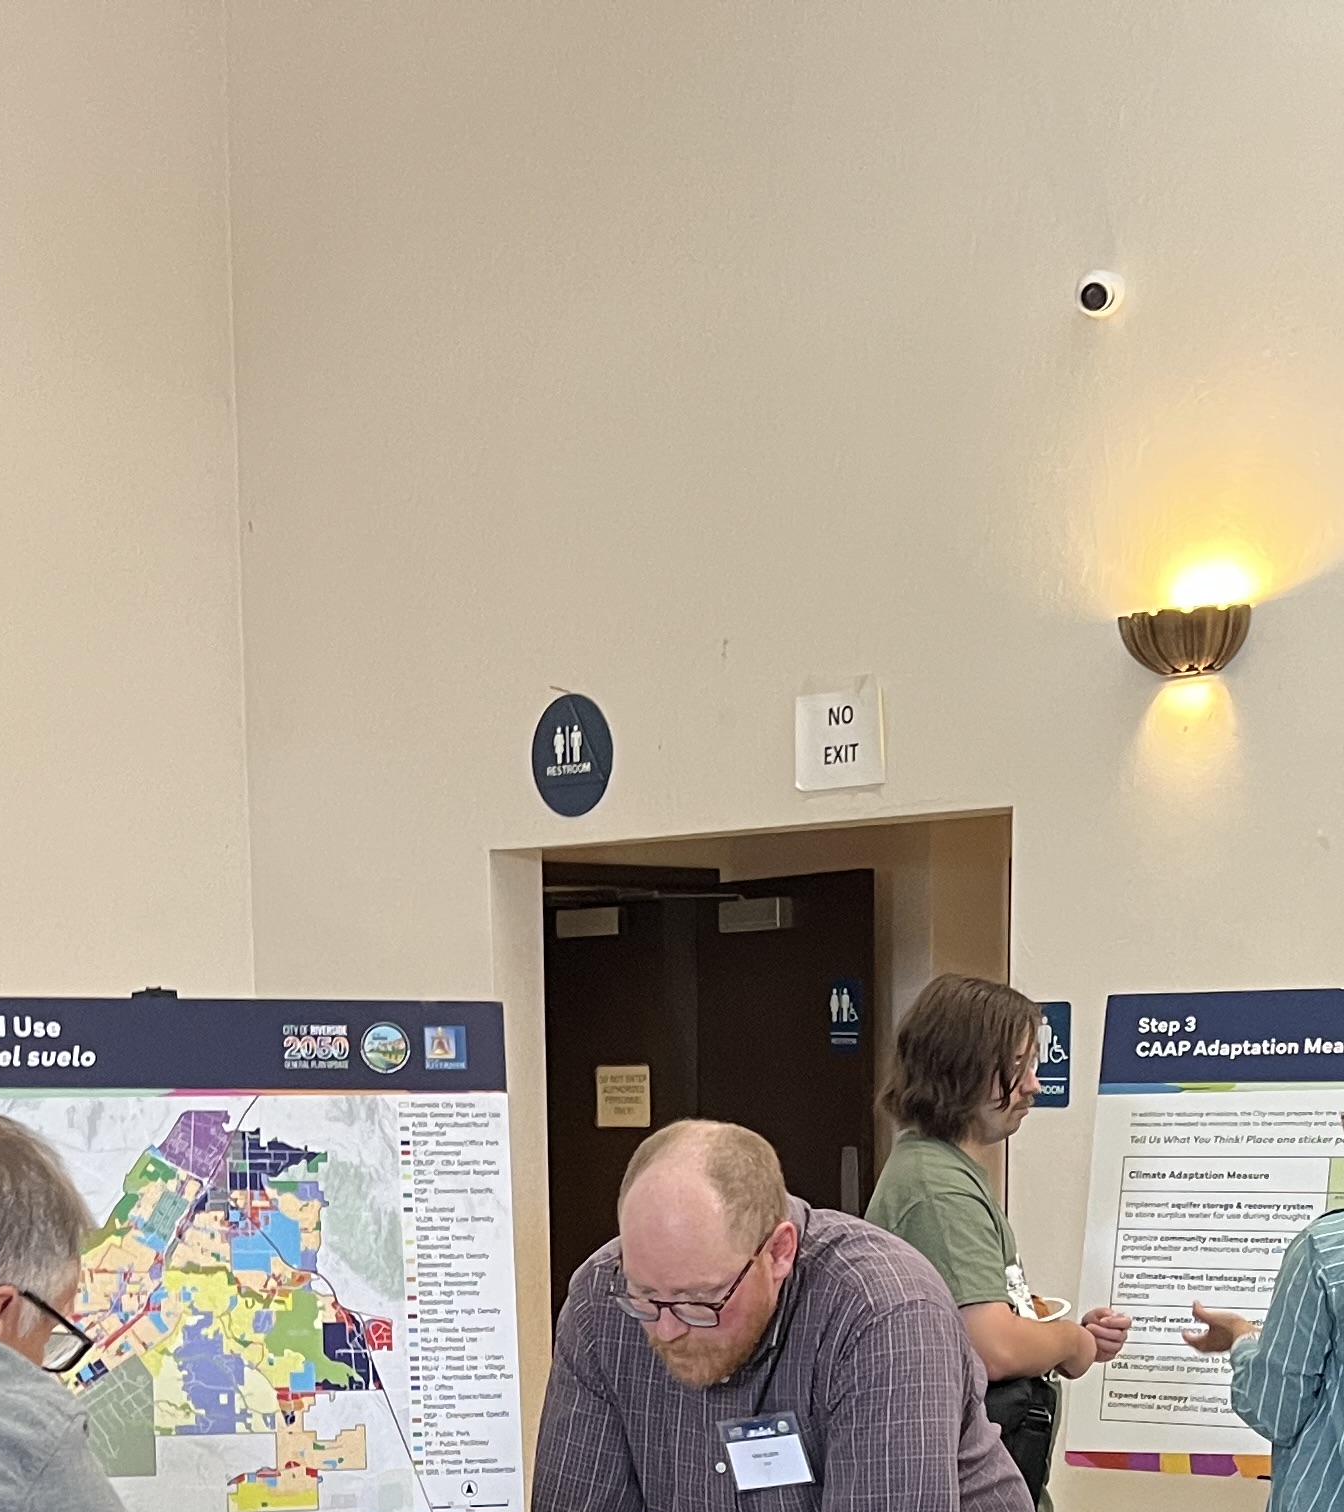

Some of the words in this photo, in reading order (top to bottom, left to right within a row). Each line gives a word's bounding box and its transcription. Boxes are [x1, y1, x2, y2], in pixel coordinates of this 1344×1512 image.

[829, 706, 853, 726] NO
[824, 743, 859, 765] EXIT
[547, 762, 591, 776] RESTROOM
[14, 1016, 61, 1037] Use
[283, 1025, 298, 1035] CITY
[300, 1025, 308, 1035] OF
[1138, 1017, 1180, 1036] Step
[1184, 1016, 1196, 1032] 3
[284, 1036, 349, 1059] 2050
[1136, 1041, 1191, 1057] CAAP
[1193, 1039, 1299, 1059] Adaptation
[27, 1045, 96, 1067] suelo
[1040, 1085, 1064, 1094] ROOM
[1130, 1136, 1146, 1144] Tell
[1149, 1136, 1161, 1144] Us
[1163, 1136, 1190, 1144] What
[1194, 1136, 1211, 1144] You
[1214, 1135, 1244, 1144] Think!
[1246, 1135, 1274, 1144] Place
[1298, 1135, 1332, 1144] sticker
[1129, 1171, 1166, 1180] Climate
[1169, 1171, 1224, 1181] Adaptation
[1227, 1171, 1269, 1180] Measure
[1126, 1202, 1169, 1210] Implement
[1171, 1202, 1200, 1210] aquifer
[1202, 1202, 1233, 1211] storage
[1244, 1203, 1280, 1211] recovery
[1283, 1203, 1313, 1211] system
[1213, 1211, 1224, 1219] for
[1243, 1212, 1269, 1221] during
[1272, 1213, 1310, 1221] droughts
[1123, 1234, 1158, 1243] Organize
[1160, 1235, 1206, 1244] community
[1209, 1235, 1248, 1243] resilience
[1251, 1236, 1282, 1244] centers
[1122, 1244, 1152, 1252] provide
[1154, 1244, 1181, 1252] shelter
[1242, 1246, 1269, 1254] during
[1136, 1272, 1203, 1281] climate-resilient
[1206, 1274, 1256, 1283] landscaping
[1118, 1281, 1174, 1290] developments
[1187, 1283, 1212, 1291] better
[1215, 1284, 1255, 1292] withstand
[1118, 1354, 1154, 1362] ncourage
[1156, 1355, 1209, 1363] communities
[1111, 1362, 1128, 1370] USA
[1130, 1363, 1174, 1373] recognized
[1176, 1364, 1185, 1372] to
[1187, 1365, 1219, 1373] prepare
[1109, 1391, 1138, 1400] Expand
[1141, 1392, 1156, 1400] tree
[1159, 1394, 1188, 1403] canopy
[1190, 1394, 1227, 1405] including
[1108, 1401, 1154, 1409] commercial
[1156, 1403, 1171, 1411] and
[1174, 1404, 1198, 1413] public
[1200, 1405, 1218, 1413] land
